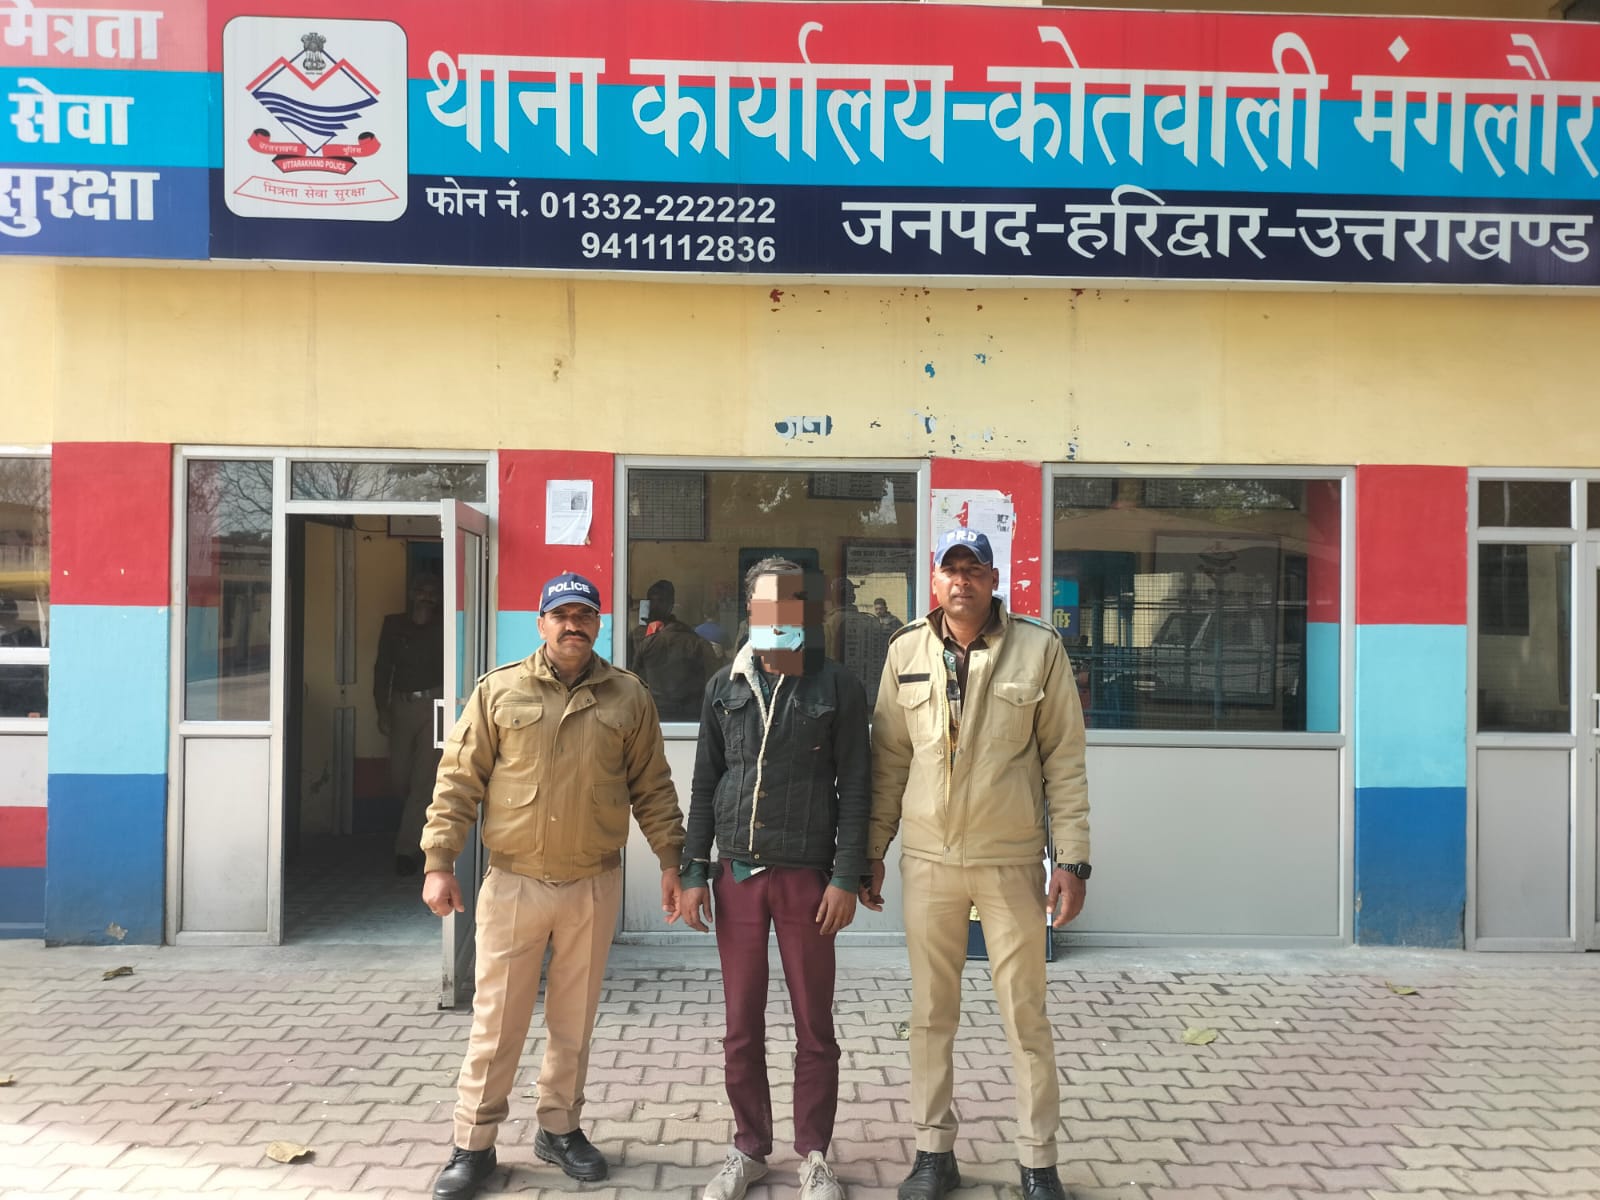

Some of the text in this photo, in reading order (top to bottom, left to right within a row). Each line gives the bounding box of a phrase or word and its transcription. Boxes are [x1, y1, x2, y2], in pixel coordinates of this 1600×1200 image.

[9, 78, 134, 145] सेवा
[427, 21, 1600, 177] थाना कार्यालय-कोतवाली मंगलौर
[282, 159, 347, 171] UTTARAKHAND POLICE
[263, 181, 367, 201] मित्रता सेवा सुरक्षा
[426, 177, 776, 224] फोन नं. 01332-222222
[842, 184, 1594, 264] जनपद-हरिद्वार-उत्तराखण्ड
[581, 231, 776, 263] 9411112836
[946, 530, 977, 543] PRD
[548, 580, 590, 596] POLICE
